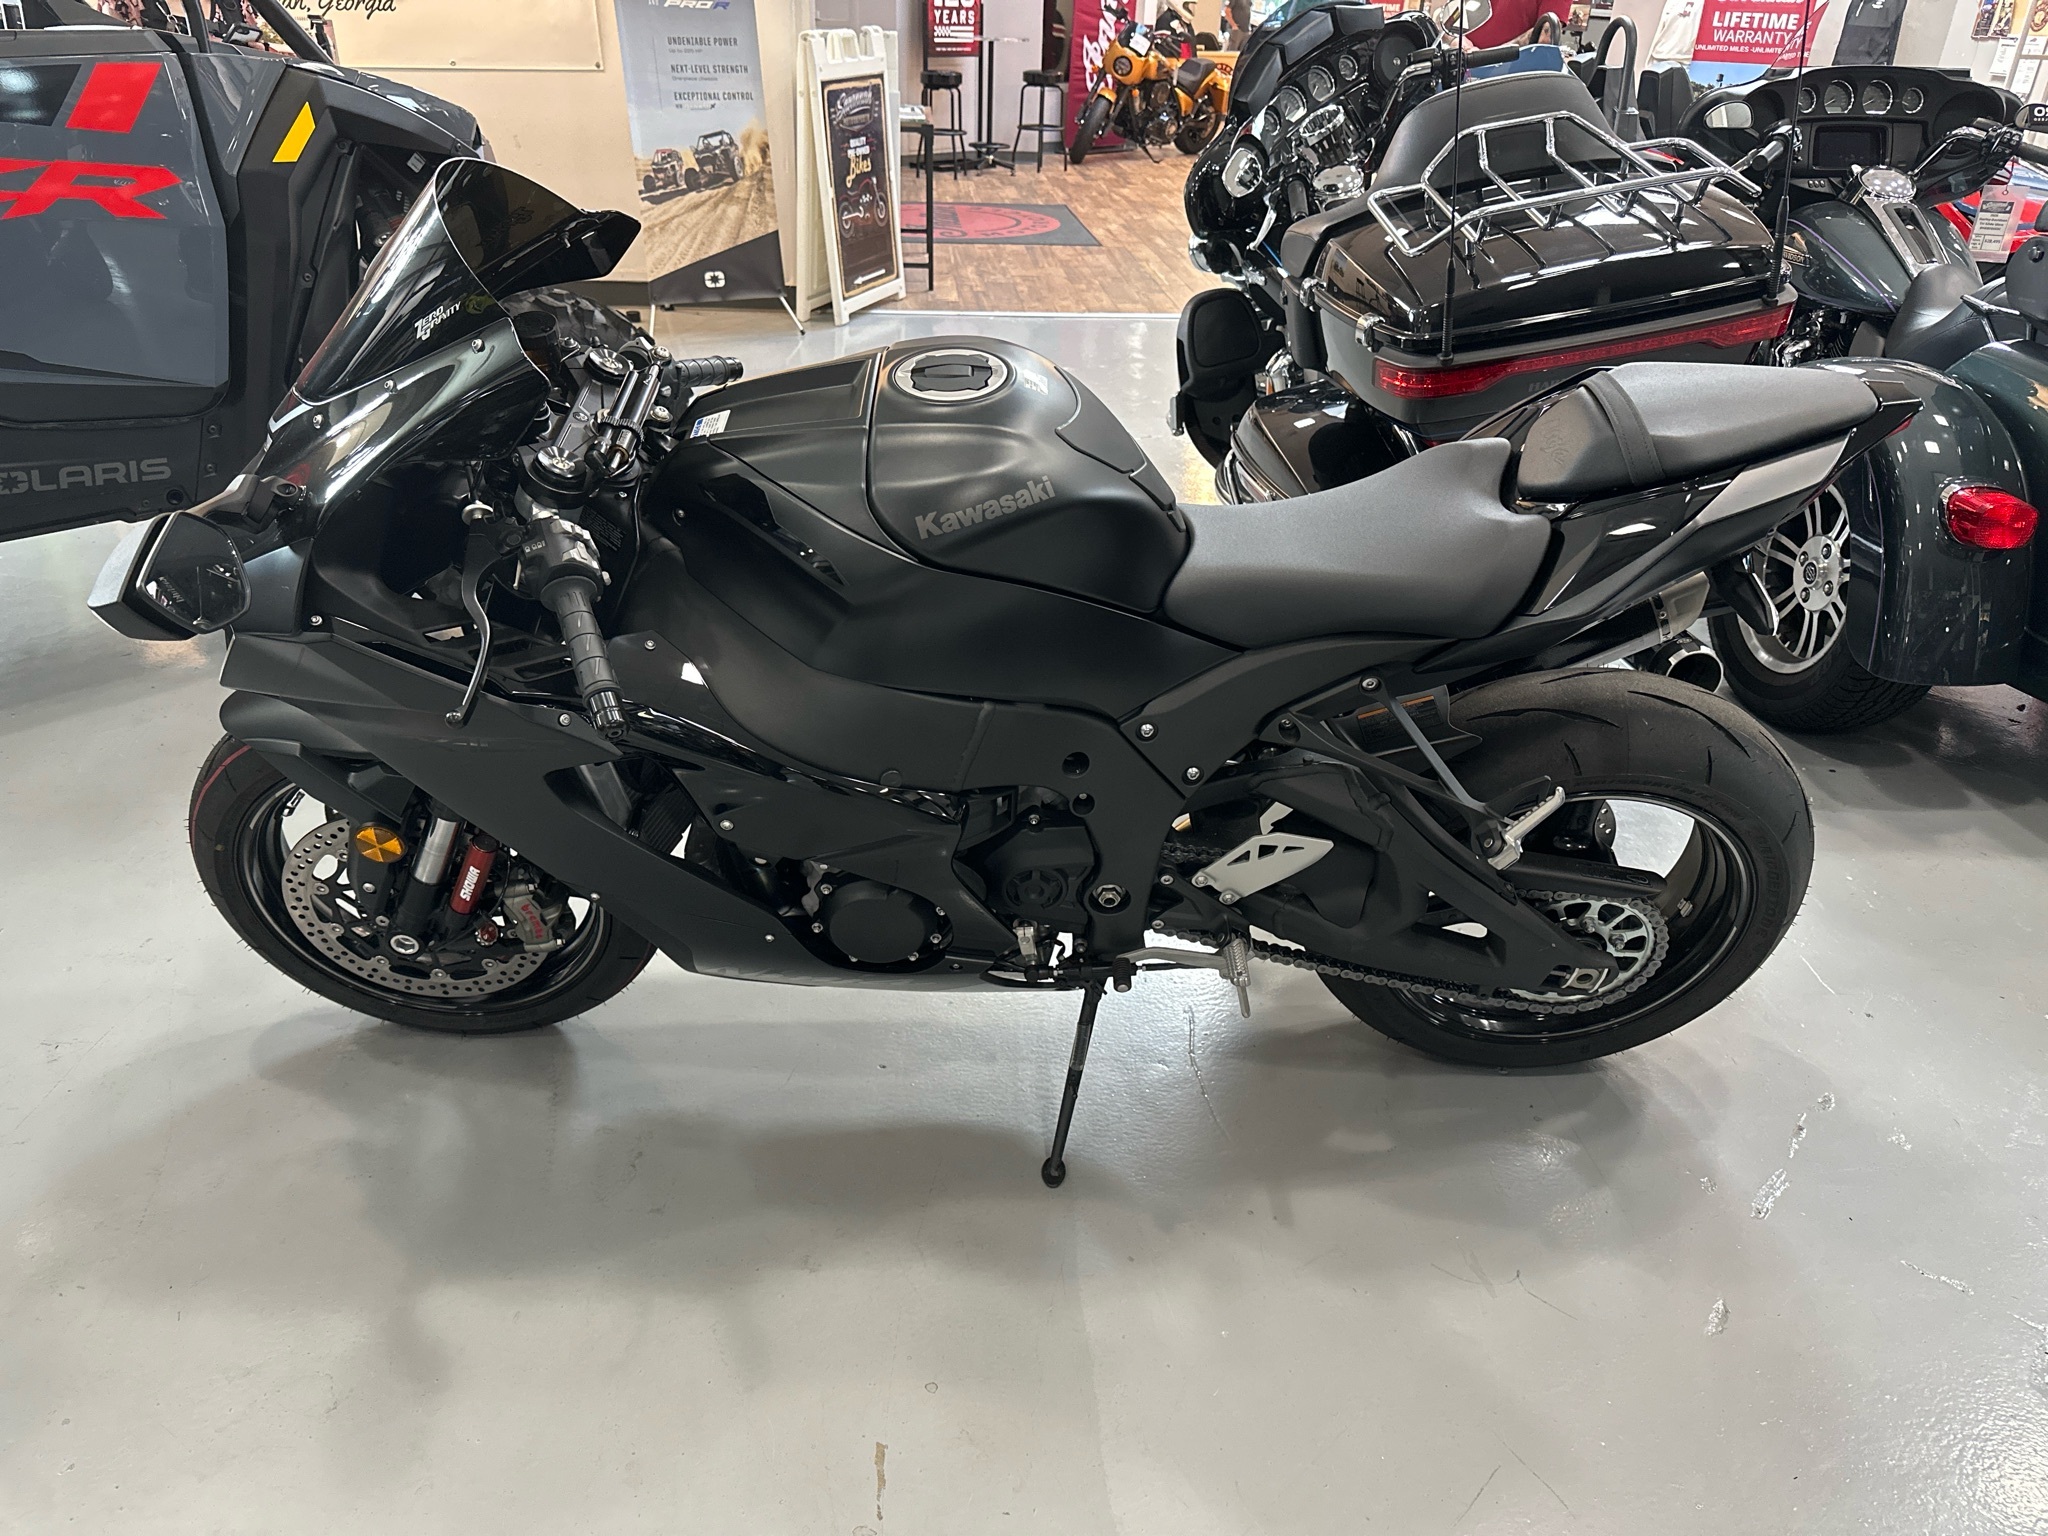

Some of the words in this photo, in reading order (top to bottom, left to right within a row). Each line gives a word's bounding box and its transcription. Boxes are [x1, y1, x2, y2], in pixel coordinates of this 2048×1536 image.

[318, 0, 396, 19] Georgia
[934, 9, 975, 25] YEARS
[1712, 11, 1800, 30] LIFETIME
[667, 36, 712, 46] UNDENIABLE
[713, 37, 738, 47] POWER
[1713, 29, 1793, 45] WARRANTY
[1694, 44, 1729, 52] UNLIMITED
[1729, 45, 1749, 53] MILES
[670, 64, 711, 74] NEXT-LEVEL
[712, 64, 749, 74] STRENGTH
[673, 91, 721, 101] EXCEPTIONAL
[722, 92, 754, 102] CONTROL
[414, 305, 444, 339] ZERO
[421, 301, 461, 340] GRAVITY
[915, 475, 1056, 540] Kawasaki
[460, 865, 480, 902] SHOWA
